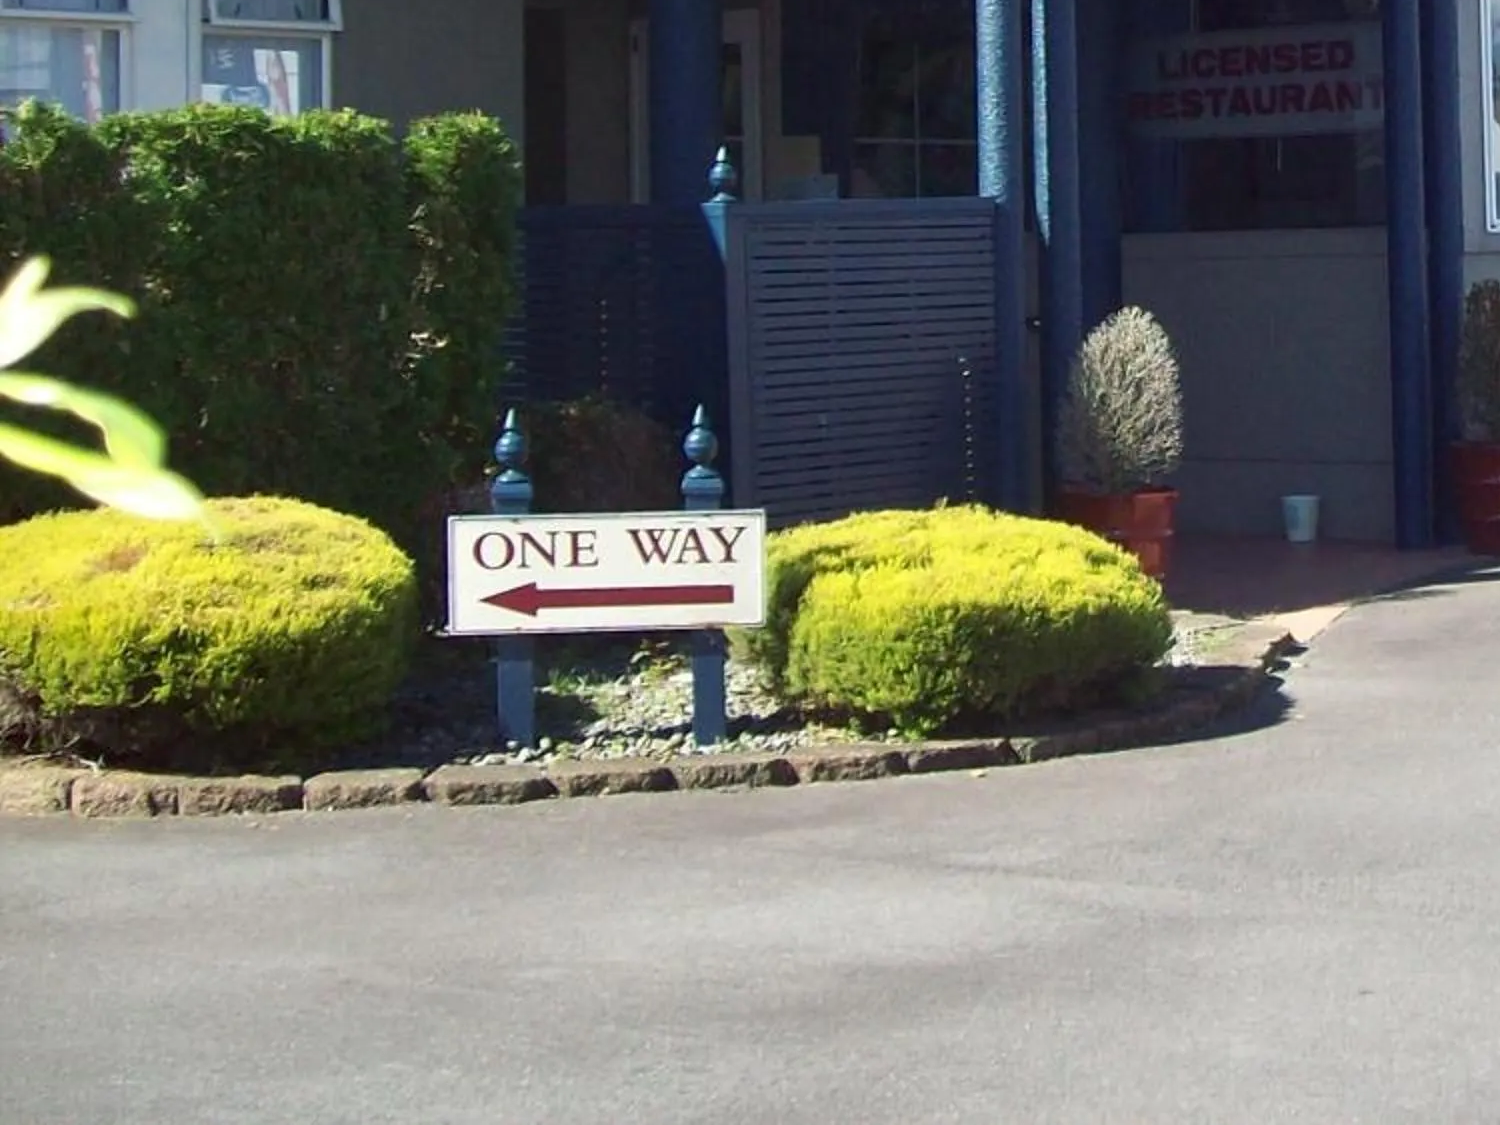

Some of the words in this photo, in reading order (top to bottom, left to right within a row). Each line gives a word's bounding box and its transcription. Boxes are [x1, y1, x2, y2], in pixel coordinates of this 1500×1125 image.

[1157, 40, 1355, 79] LICENSED
[1129, 76, 1383, 121] RESTAURANT
[472, 529, 600, 571] ONE
[626, 525, 748, 565] WAY
